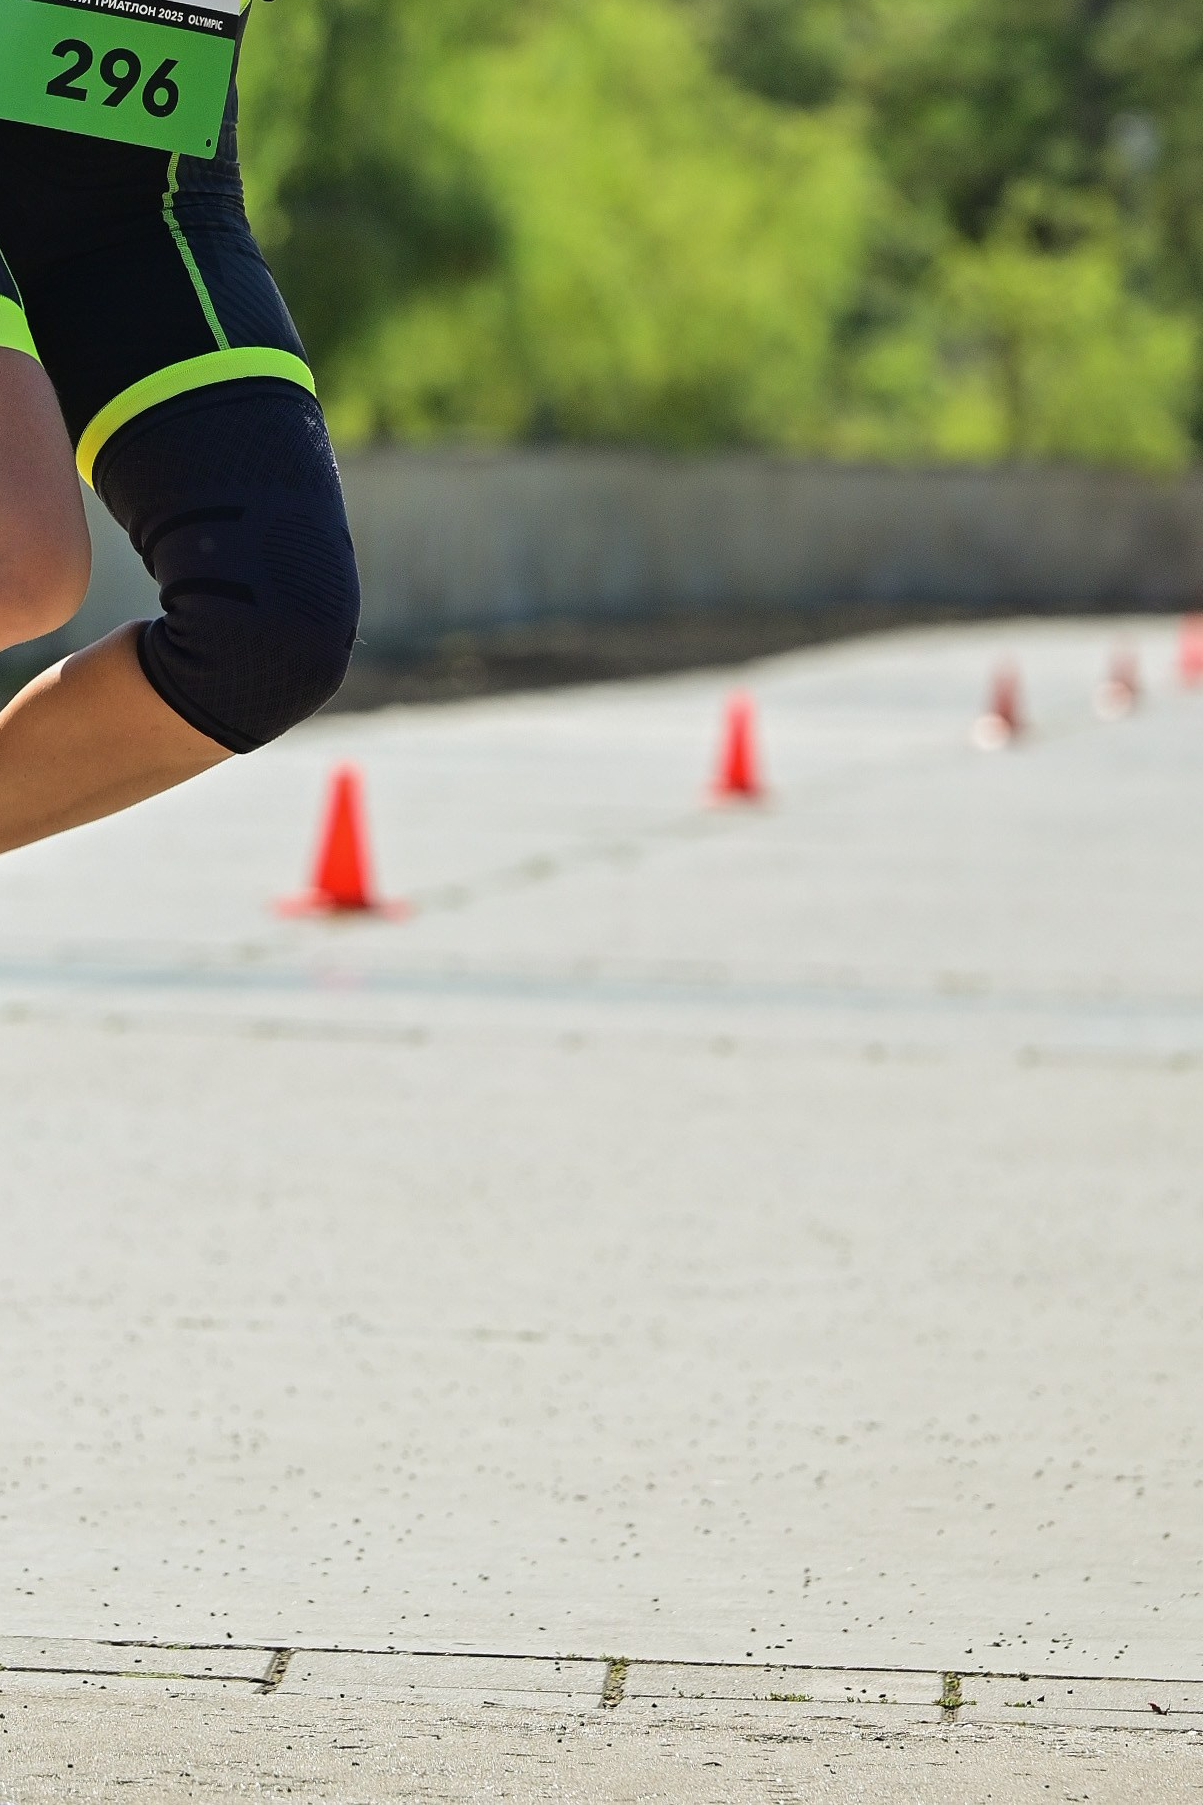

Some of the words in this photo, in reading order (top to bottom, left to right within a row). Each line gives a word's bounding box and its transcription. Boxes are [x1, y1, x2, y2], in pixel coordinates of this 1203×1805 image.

[157, 7, 185, 23] 2025
[187, 13, 225, 32] OLYMPIC
[45, 38, 180, 119] 296
